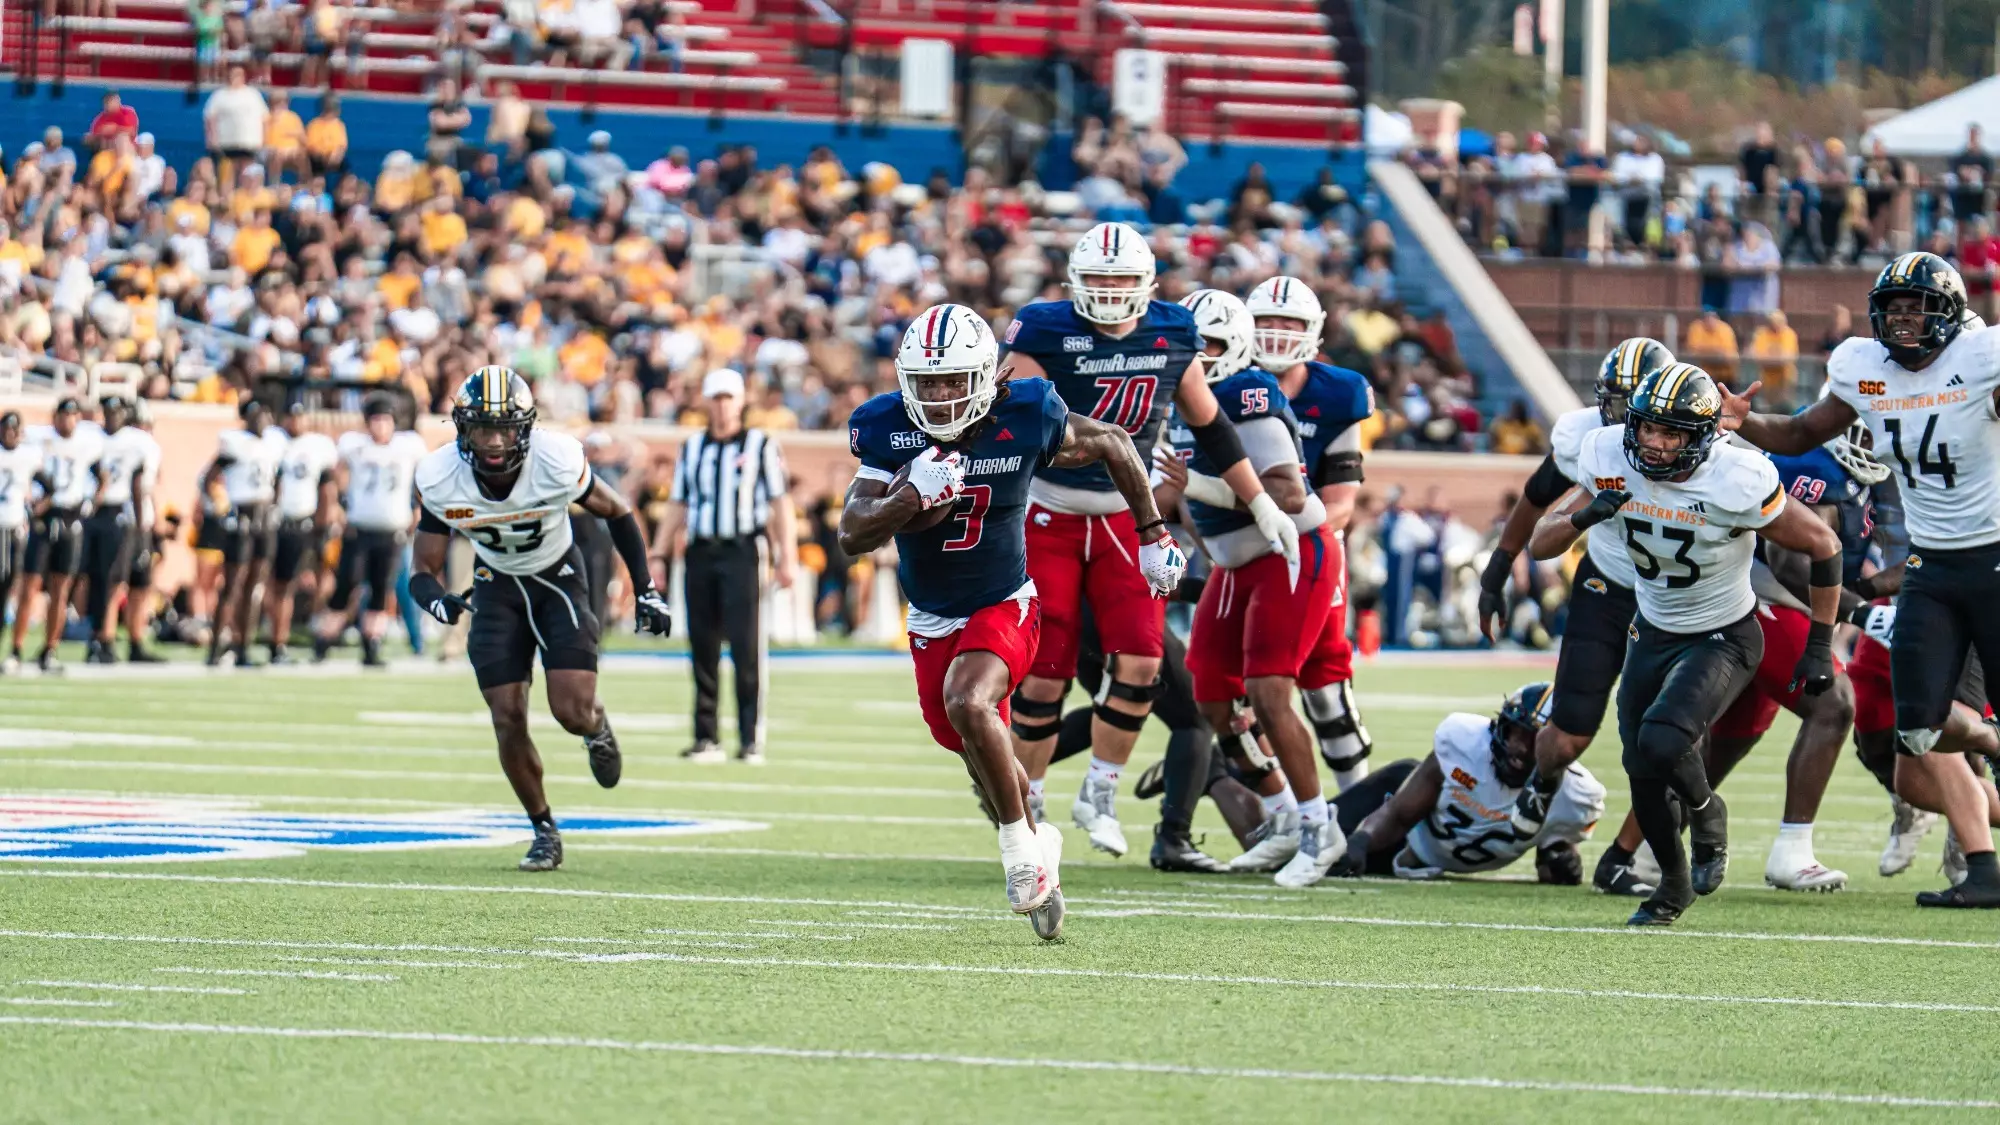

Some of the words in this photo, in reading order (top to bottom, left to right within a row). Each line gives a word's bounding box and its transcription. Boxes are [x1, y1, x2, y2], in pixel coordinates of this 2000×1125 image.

[1240, 387, 1269, 415] 55
[1858, 380, 1886, 395] SBC
[1870, 395, 1934, 411] SOUTHERN
[1937, 389, 1968, 405] MISS
[1089, 375, 1159, 436] 70
[890, 431, 926, 449] SBC
[1883, 413, 1957, 489] 14
[1594, 476, 1626, 490] SBC
[1790, 474, 1827, 504] 69
[942, 485, 992, 552] 3
[1620, 501, 1673, 520] OUTHERN
[1675, 510, 1706, 526] MISS
[1623, 516, 1700, 588] 53
[1428, 803, 1516, 865] 36
